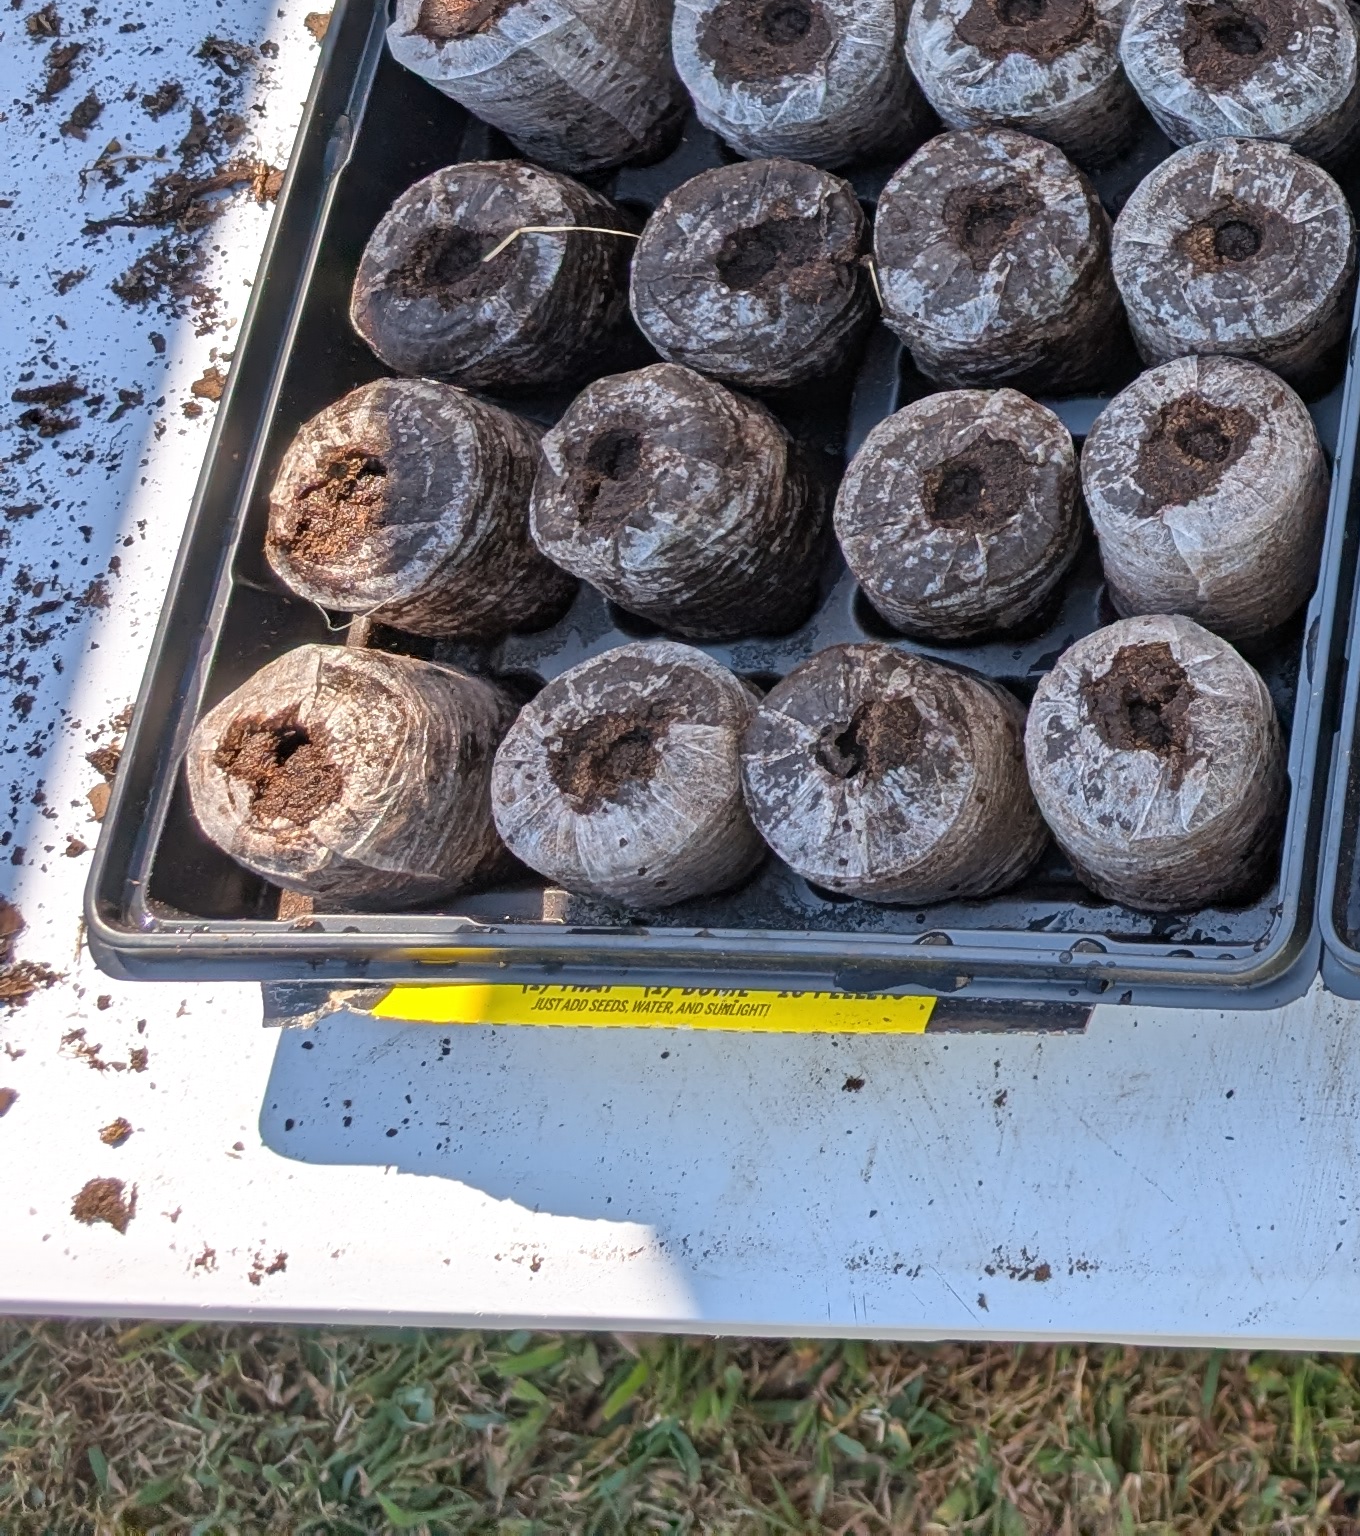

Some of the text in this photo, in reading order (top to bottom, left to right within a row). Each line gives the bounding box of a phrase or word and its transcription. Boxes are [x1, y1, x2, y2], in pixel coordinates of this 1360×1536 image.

[531, 997, 772, 1018] JUST ADD SEEDS, WATER, AND SUNLIGHT!
